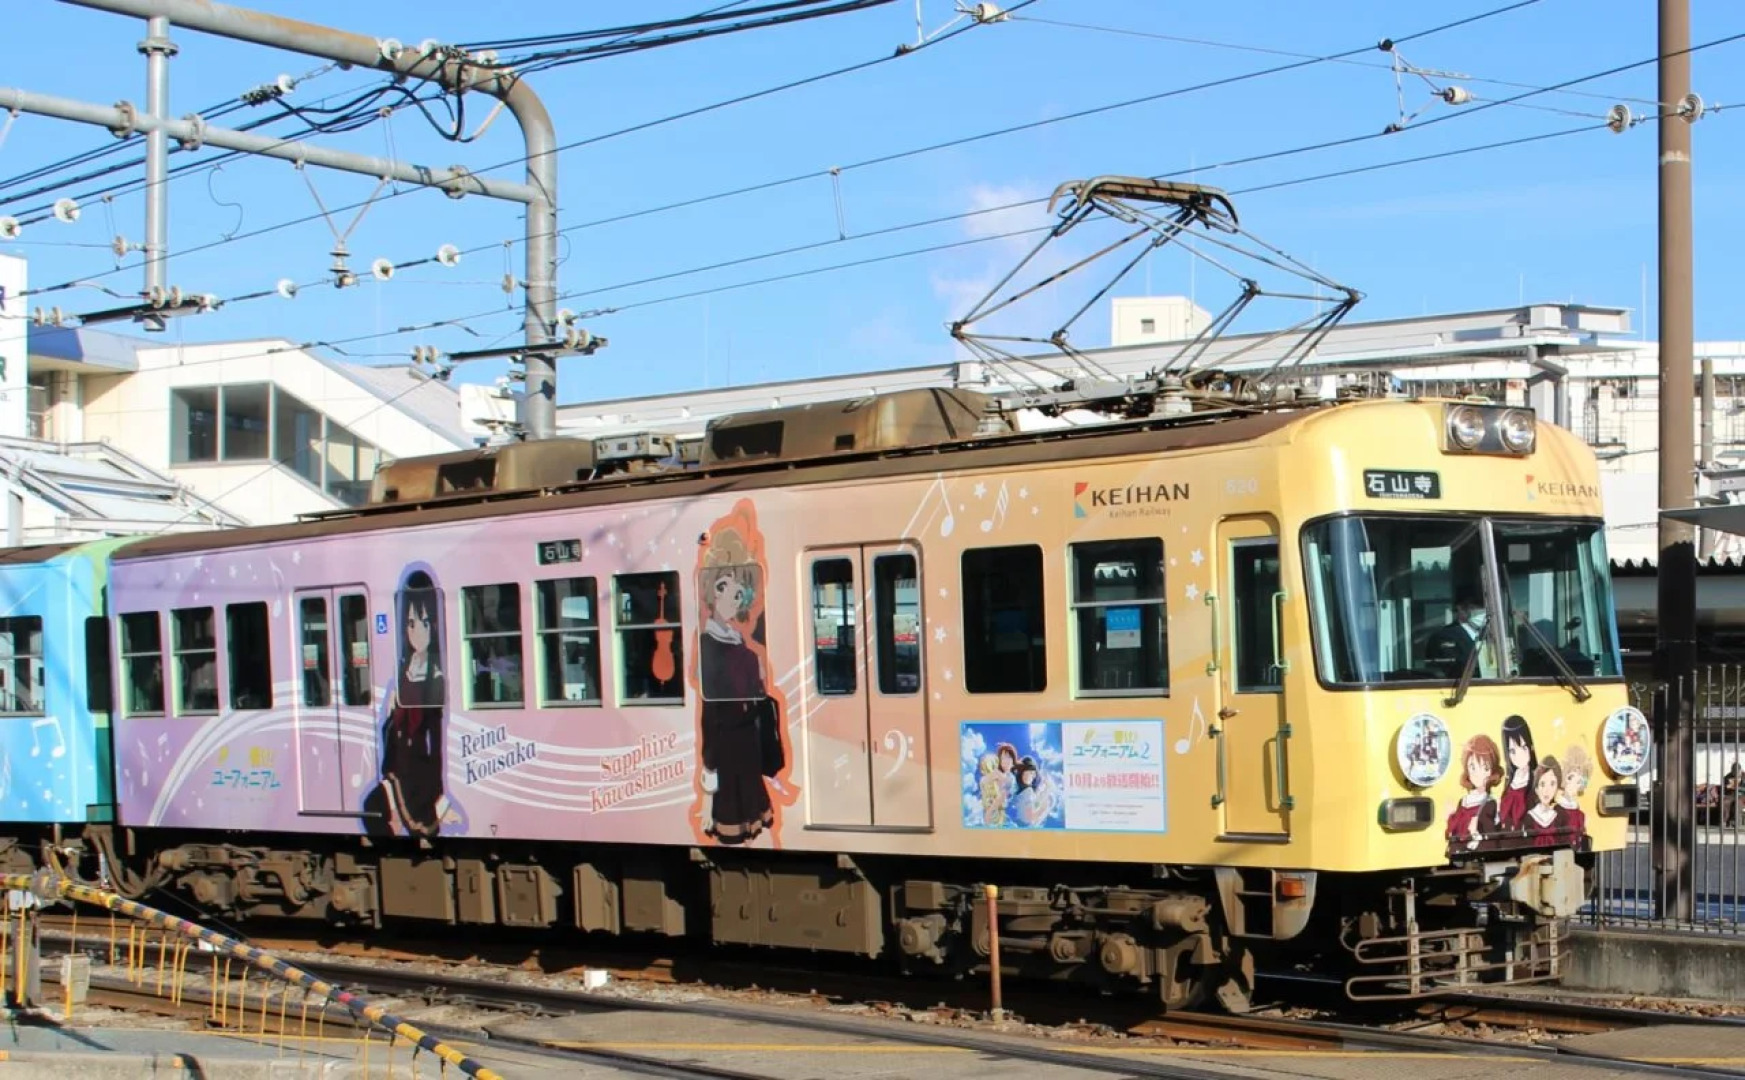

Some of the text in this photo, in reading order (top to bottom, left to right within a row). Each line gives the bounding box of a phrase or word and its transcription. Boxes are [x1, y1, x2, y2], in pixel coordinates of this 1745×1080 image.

[1091, 483, 1190, 507] KEIHAN
[1366, 473, 1432, 494] 石山寺
[1538, 481, 1599, 498] KEIHAN
[461, 725, 506, 758] Reina
[601, 731, 677, 779] Sapphire
[466, 742, 537, 785] Kousaka
[591, 759, 684, 813] Kawashima
